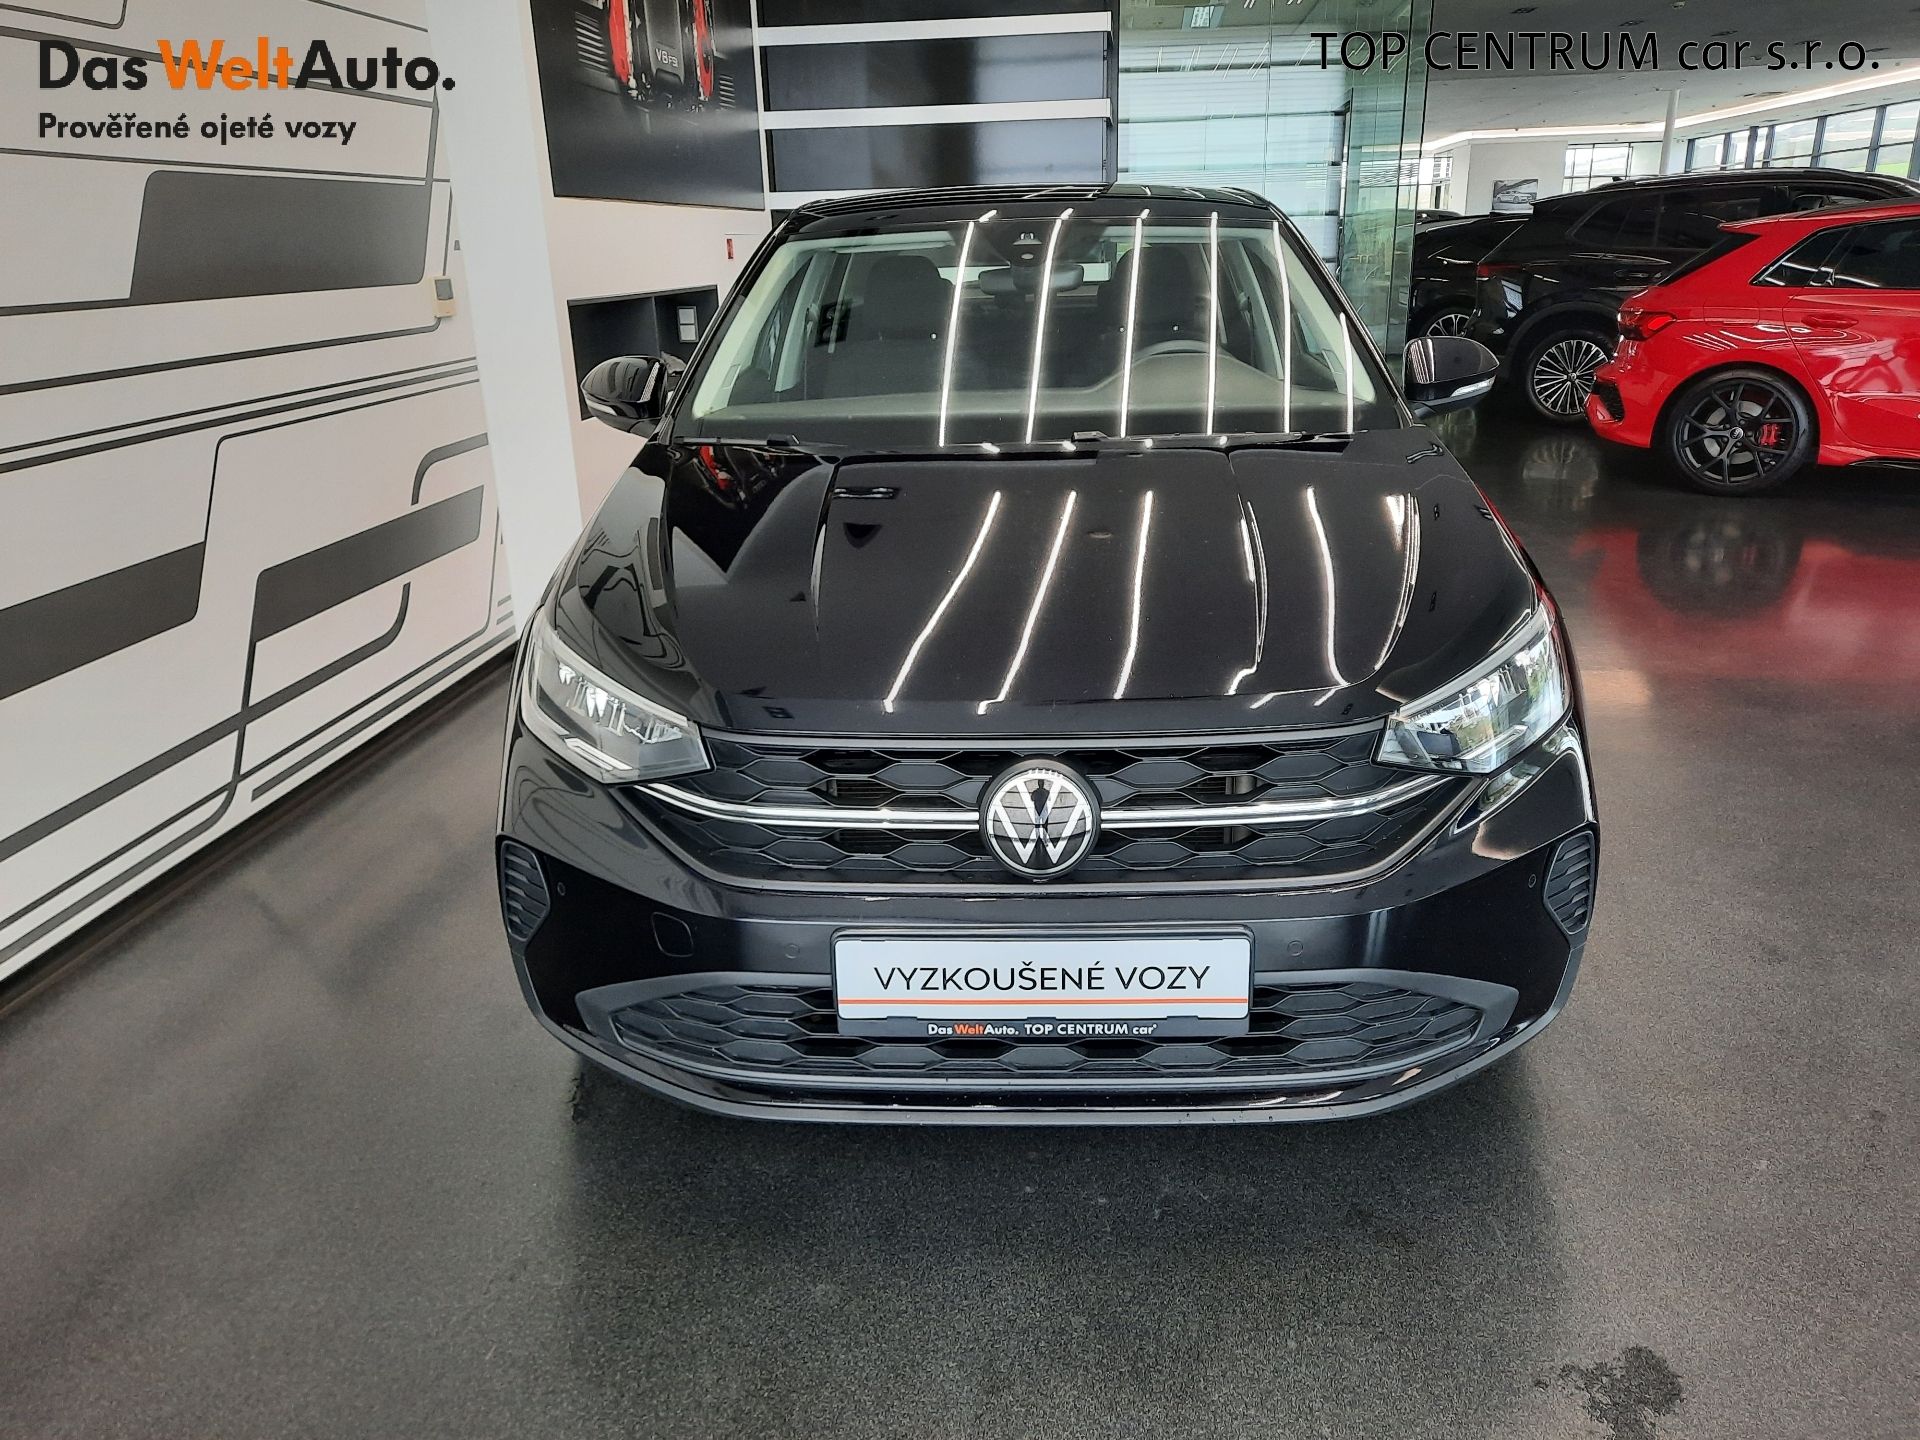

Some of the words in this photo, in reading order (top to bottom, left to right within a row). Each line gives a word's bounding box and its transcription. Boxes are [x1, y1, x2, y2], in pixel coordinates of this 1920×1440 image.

[873, 960, 1106, 991] VYZKOUŠENÉ
[1114, 965, 1211, 990] VOZY
[927, 1023, 953, 1035] Das
[1024, 1023, 1054, 1035] TOP
[1056, 1023, 1129, 1035] CENTRUM
